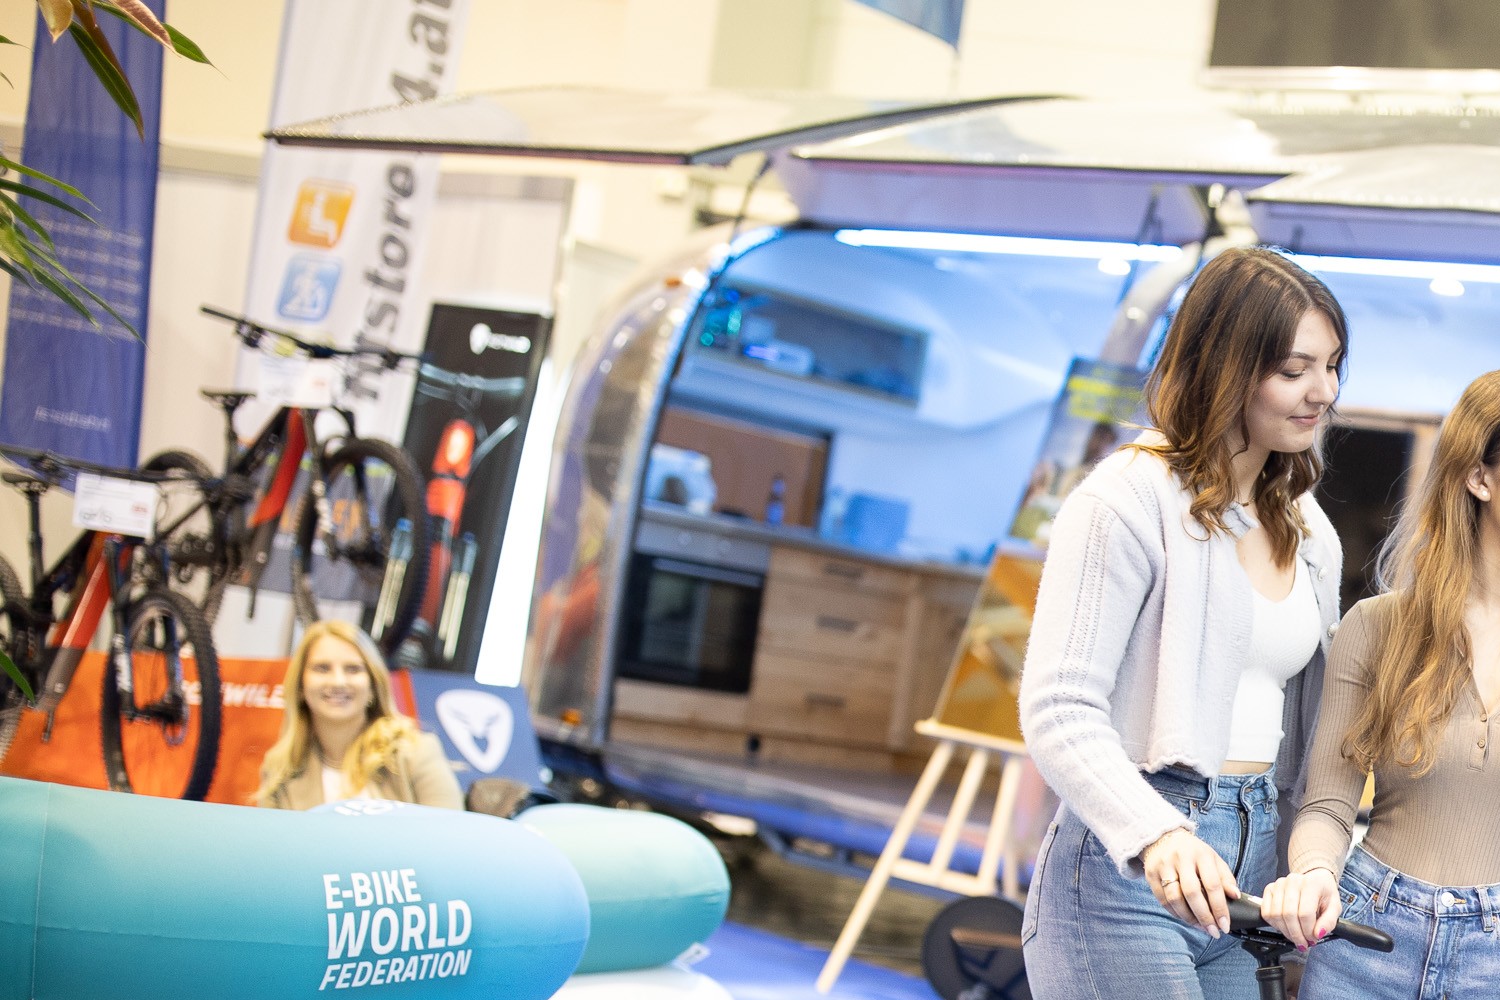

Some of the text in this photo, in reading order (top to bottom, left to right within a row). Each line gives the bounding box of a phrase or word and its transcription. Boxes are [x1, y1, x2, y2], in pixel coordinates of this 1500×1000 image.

[323, 868, 422, 910] E-BIKE
[327, 899, 473, 960] WORLD
[318, 948, 473, 991] FEDERATION
